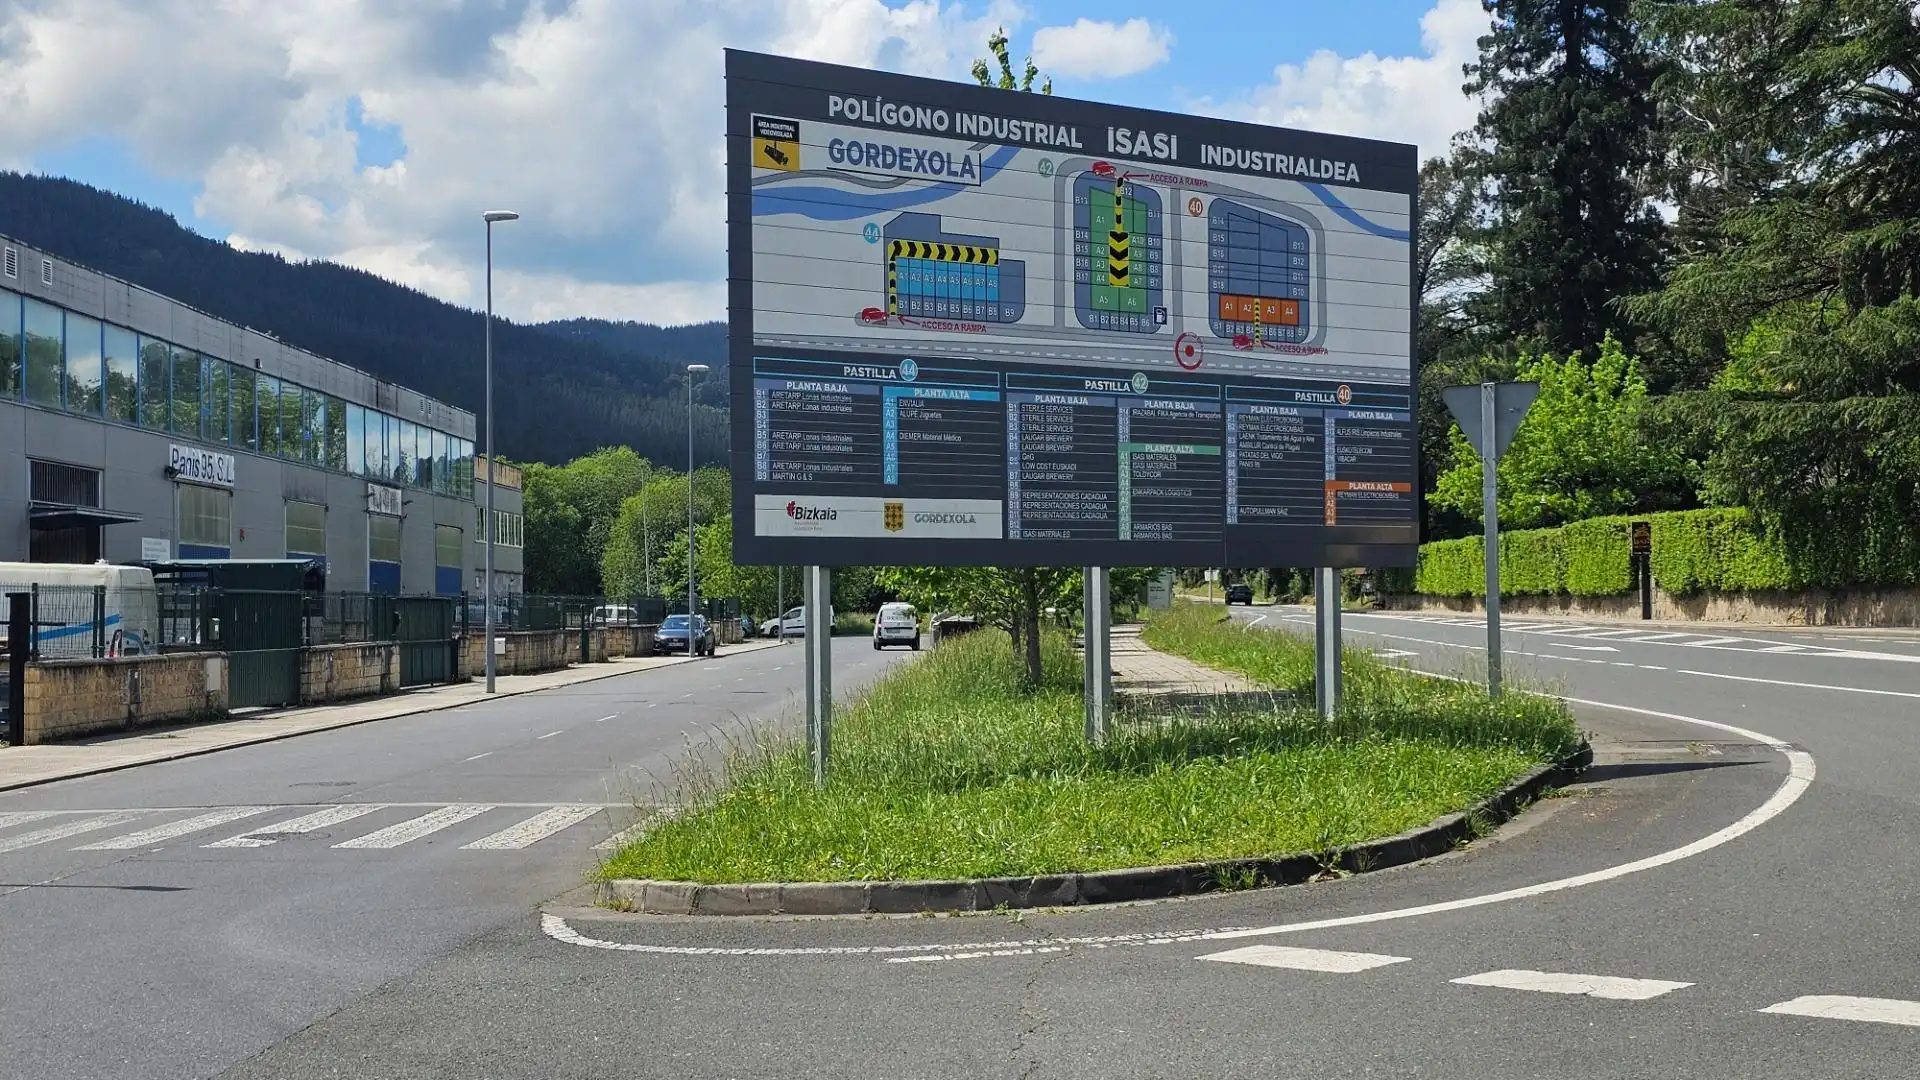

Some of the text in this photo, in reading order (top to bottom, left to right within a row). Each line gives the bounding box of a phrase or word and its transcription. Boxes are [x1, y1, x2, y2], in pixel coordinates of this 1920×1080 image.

[829, 95, 1361, 183] POLÍGONO INDUSTRIAL ISASI INDUSTRIALDEA
[828, 138, 976, 179] GORDEXOLA
[1039, 161, 1053, 175] 42
[1150, 175, 1178, 184] ACCESO
[1185, 178, 1208, 187] RAMPA
[1120, 188, 1132, 196] B12
[1188, 201, 1202, 214] 40
[1096, 216, 1104, 224] A1
[865, 226, 878, 240] 44
[1096, 247, 1104, 256] A2
[1096, 260, 1104, 269] A3
[1096, 274, 1104, 282] A4
[1100, 296, 1108, 304] A5
[1128, 298, 1136, 306] A6
[900, 300, 908, 310] B1
[912, 301, 921, 310] B2
[924, 302, 934, 311] B3
[938, 303, 947, 312] B4
[950, 304, 960, 313] B5
[963, 305, 972, 314] B6
[1225, 302, 1232, 310] A1
[1244, 304, 1252, 312] A2
[976, 306, 985, 315] B7
[1005, 308, 1014, 318] B9
[1267, 306, 1275, 314] A3
[1285, 308, 1293, 316] A4
[1101, 316, 1110, 324] B2
[922, 322, 952, 331] ACCESO
[961, 324, 986, 332] RAMPA
[844, 363, 915, 379] PASTILLA 44
[786, 381, 848, 392] PLANTA BAJA
[1085, 377, 1146, 392] PASTILLA 42
[914, 388, 970, 399] PLANTA ALTA
[1295, 389, 1350, 402] PASTILLA 40
[1036, 395, 1088, 405] PLANTA BAJA
[772, 402, 801, 410] ARETARP
[1144, 400, 1194, 410] PLANTA BAJA
[1250, 406, 1298, 415] PLANTA BAJA
[1348, 411, 1393, 420] PLANTA BAJA
[886, 420, 894, 428] A3
[757, 430, 766, 438] B5
[772, 432, 802, 440] ARETARP
[886, 432, 894, 440] A4
[1146, 445, 1194, 454] PLANTA ALTA
[757, 451, 766, 460] B7
[171, 448, 234, 482] Panis 95, S.L.
[757, 461, 766, 470] B8
[772, 462, 802, 470] ARETARP
[757, 472, 766, 480] B9
[1349, 482, 1374, 490] PLANTA
[794, 506, 837, 520] Bizkaia
[914, 513, 976, 524] GORDEXOLA
